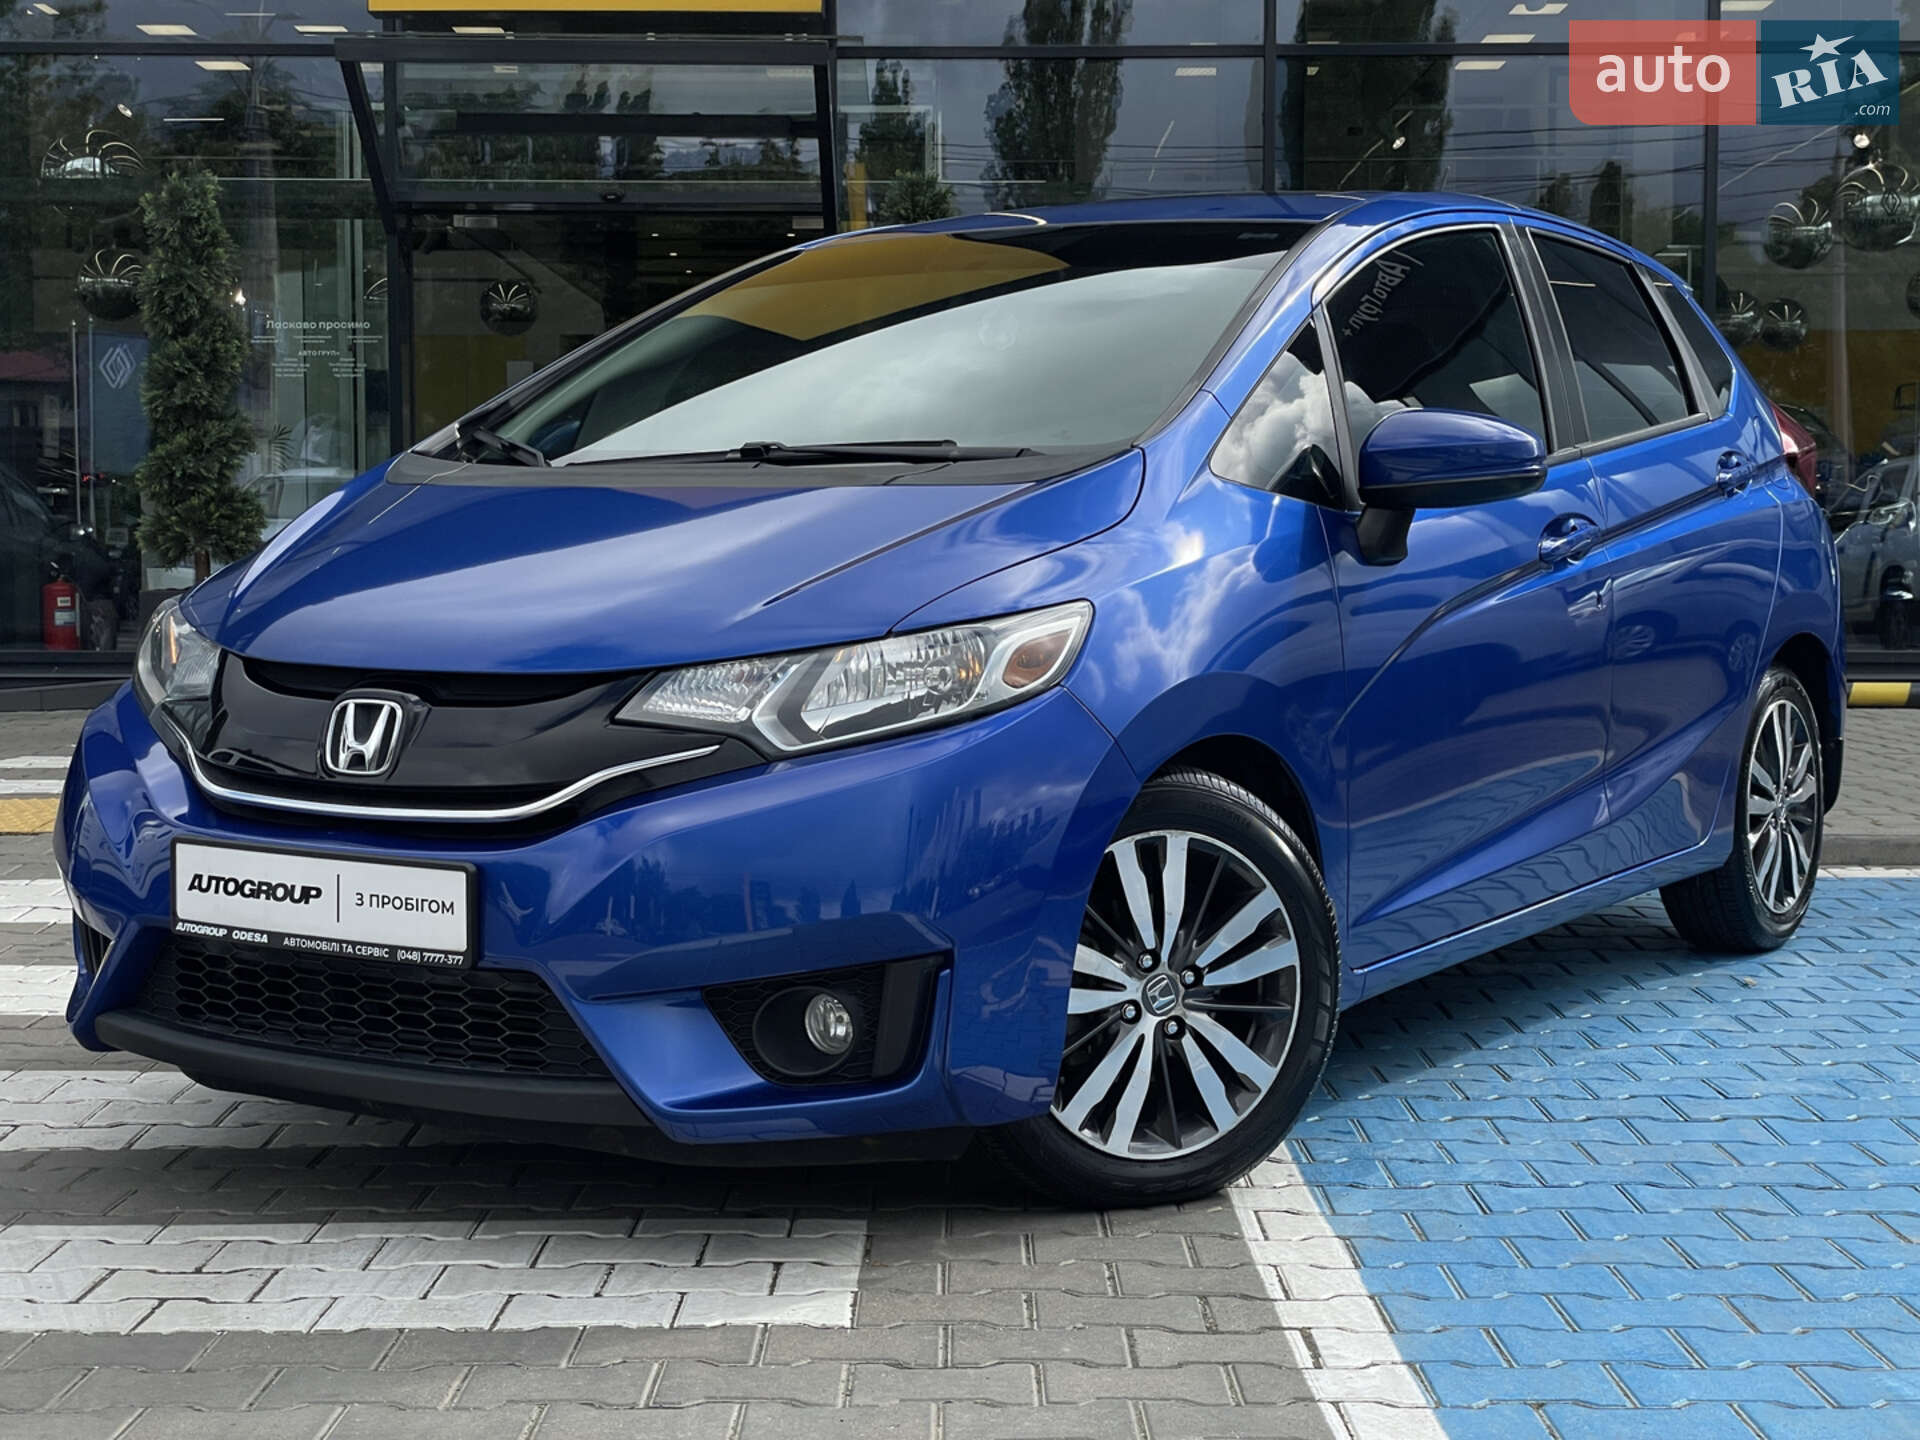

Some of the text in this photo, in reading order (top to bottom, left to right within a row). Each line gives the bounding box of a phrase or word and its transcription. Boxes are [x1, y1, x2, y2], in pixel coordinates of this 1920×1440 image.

[266, 320, 371, 331] Ласкаво просимо
[187, 873, 323, 905] AUTOGROUP
[369, 893, 455, 915] ПРОБІГОМ
[175, 921, 269, 944] AUTOGROUP ODESA
[283, 937, 390, 958] АВТОМОБІЛІ ТА СЕРВІС
[397, 949, 421, 962] (048)
